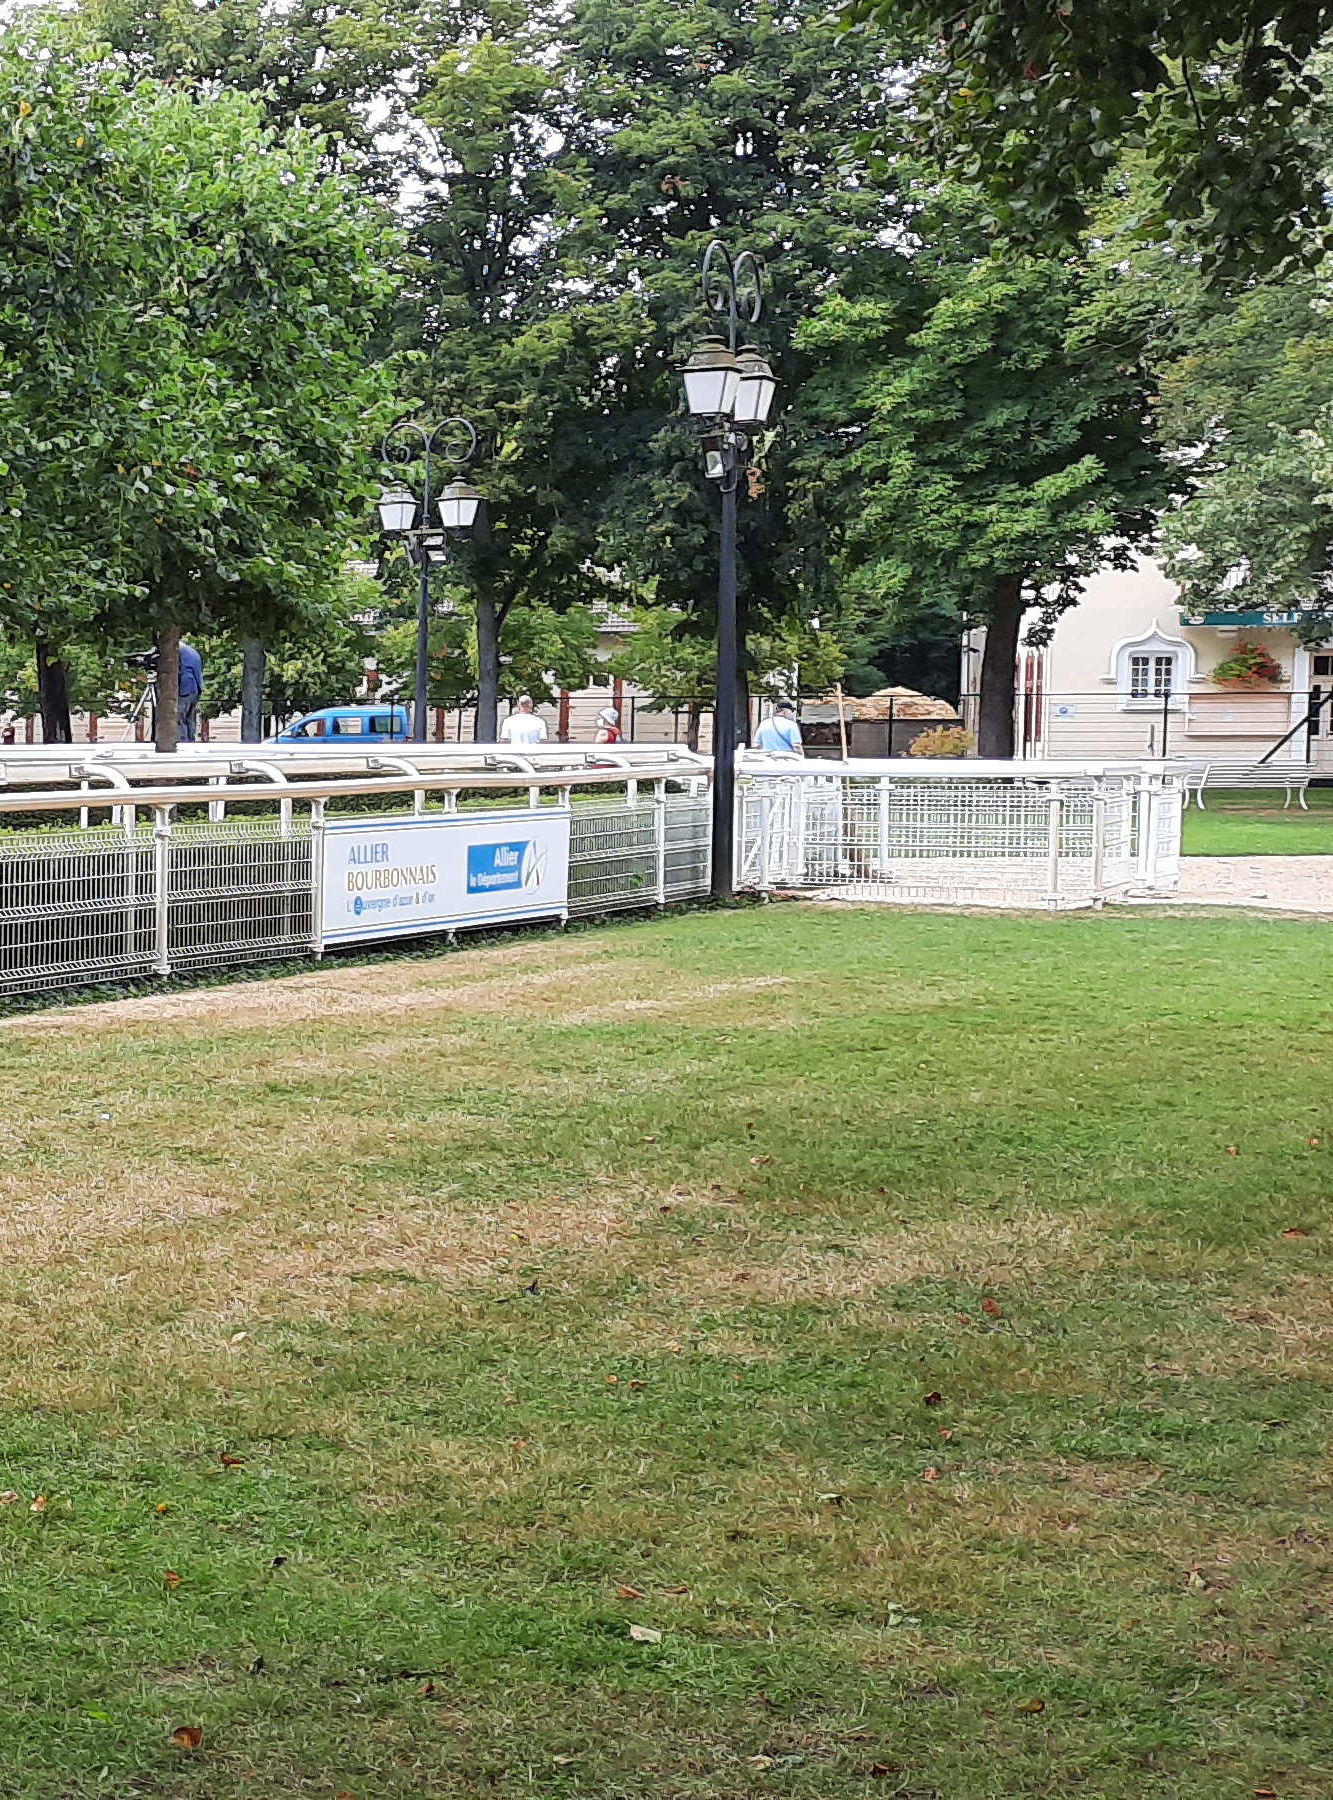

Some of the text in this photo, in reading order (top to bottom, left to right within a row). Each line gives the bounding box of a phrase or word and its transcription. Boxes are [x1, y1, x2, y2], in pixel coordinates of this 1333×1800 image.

[348, 843, 390, 865] ALLIER
[494, 846, 520, 868] Allier
[347, 864, 437, 892] BOURBONNAIS
